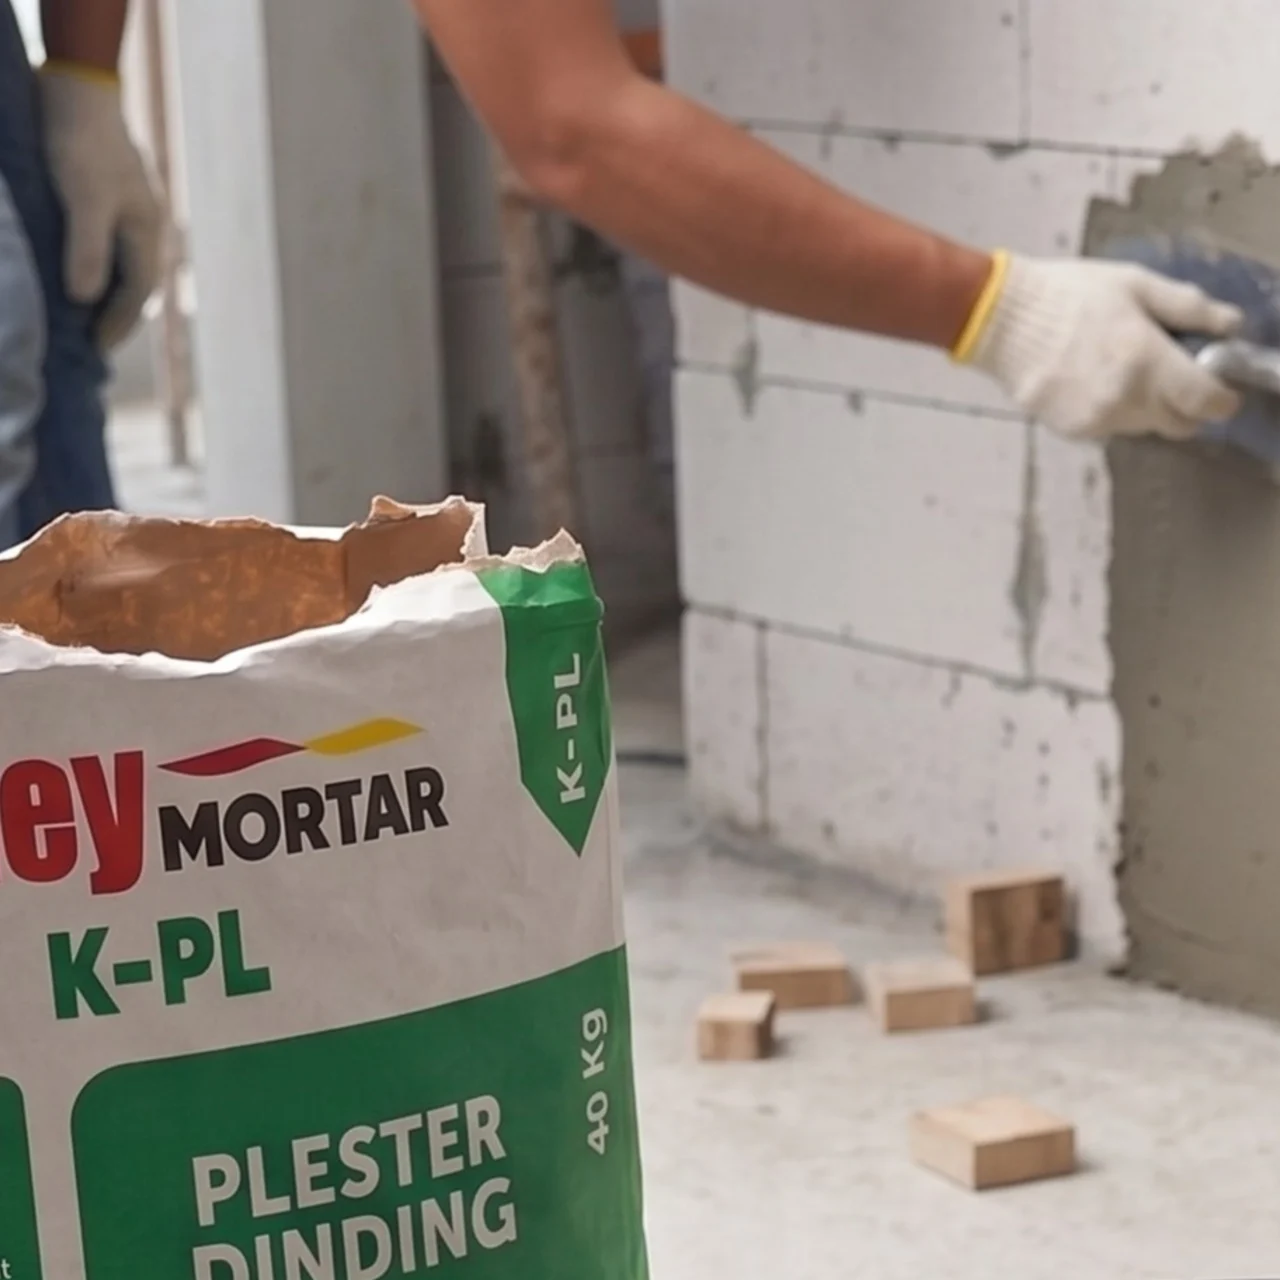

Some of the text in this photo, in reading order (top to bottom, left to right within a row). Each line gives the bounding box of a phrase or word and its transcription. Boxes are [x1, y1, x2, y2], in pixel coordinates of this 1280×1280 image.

[552, 653, 585, 804] K-PL
[0, 750, 449, 895] ey MORTAR
[47, 909, 272, 1020] K-PL
[581, 1008, 609, 1155] 40 Kg
[192, 1095, 507, 1226] PLESTER
